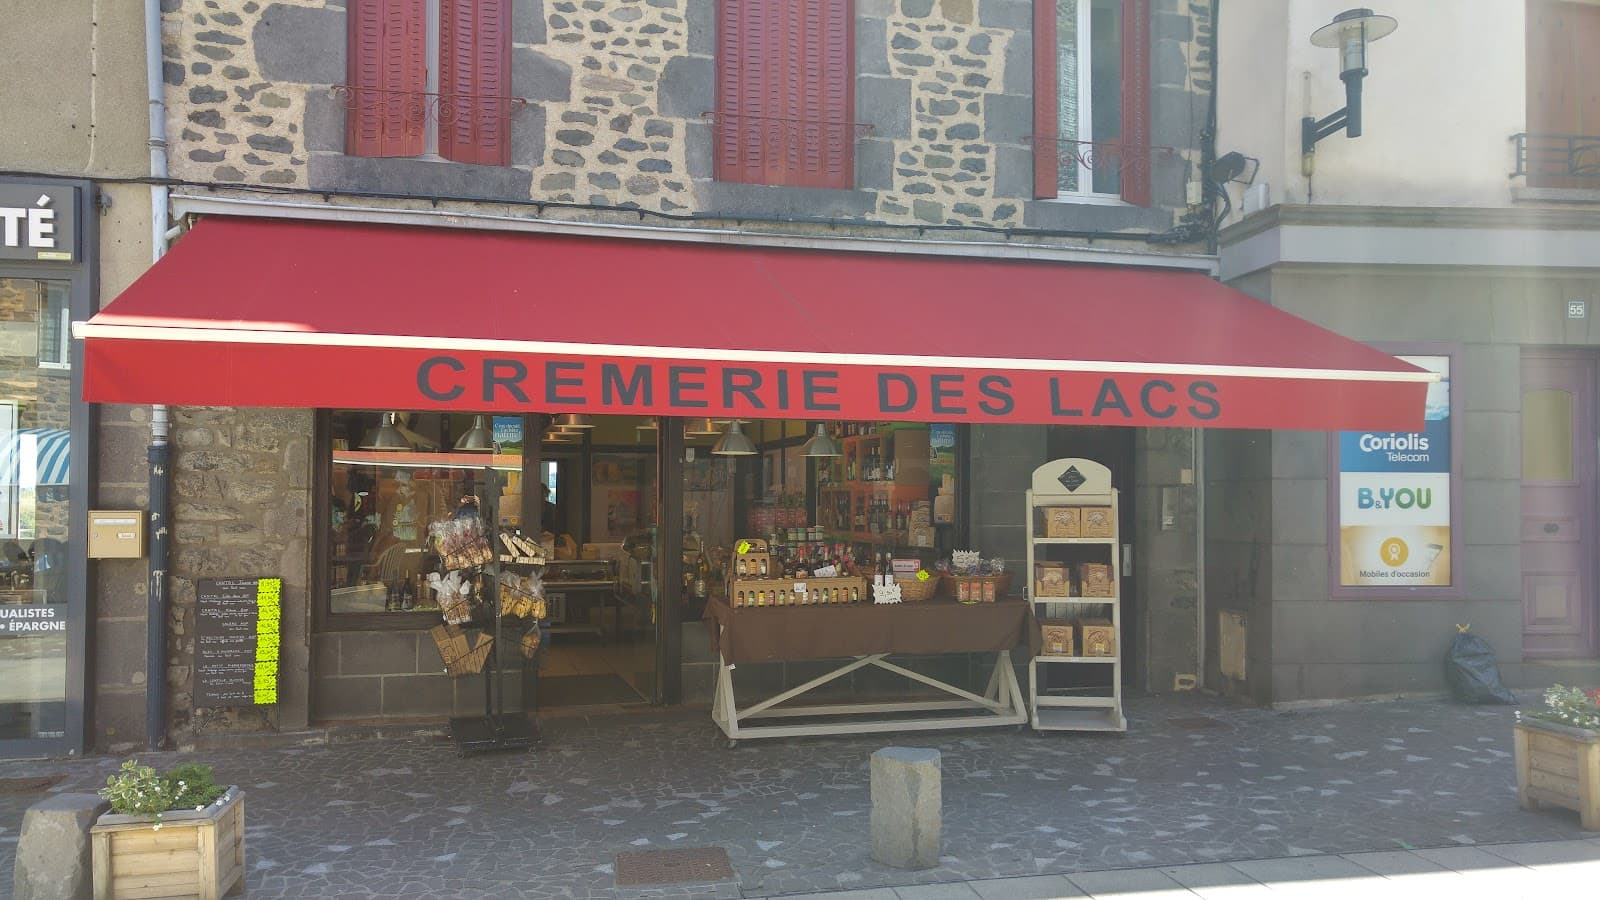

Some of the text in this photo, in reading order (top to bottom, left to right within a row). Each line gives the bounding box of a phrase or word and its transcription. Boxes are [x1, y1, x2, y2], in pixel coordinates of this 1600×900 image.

[0, 194, 55, 248] TÉ
[1570, 305, 1583, 315] 55
[418, 357, 1221, 420] CREMERIE DES LACS
[1359, 433, 1429, 452] Coriolis
[1386, 452, 1429, 462] Telecom
[1358, 487, 1432, 509] B&YOU
[9, 619, 66, 631] ÉPARGNE
